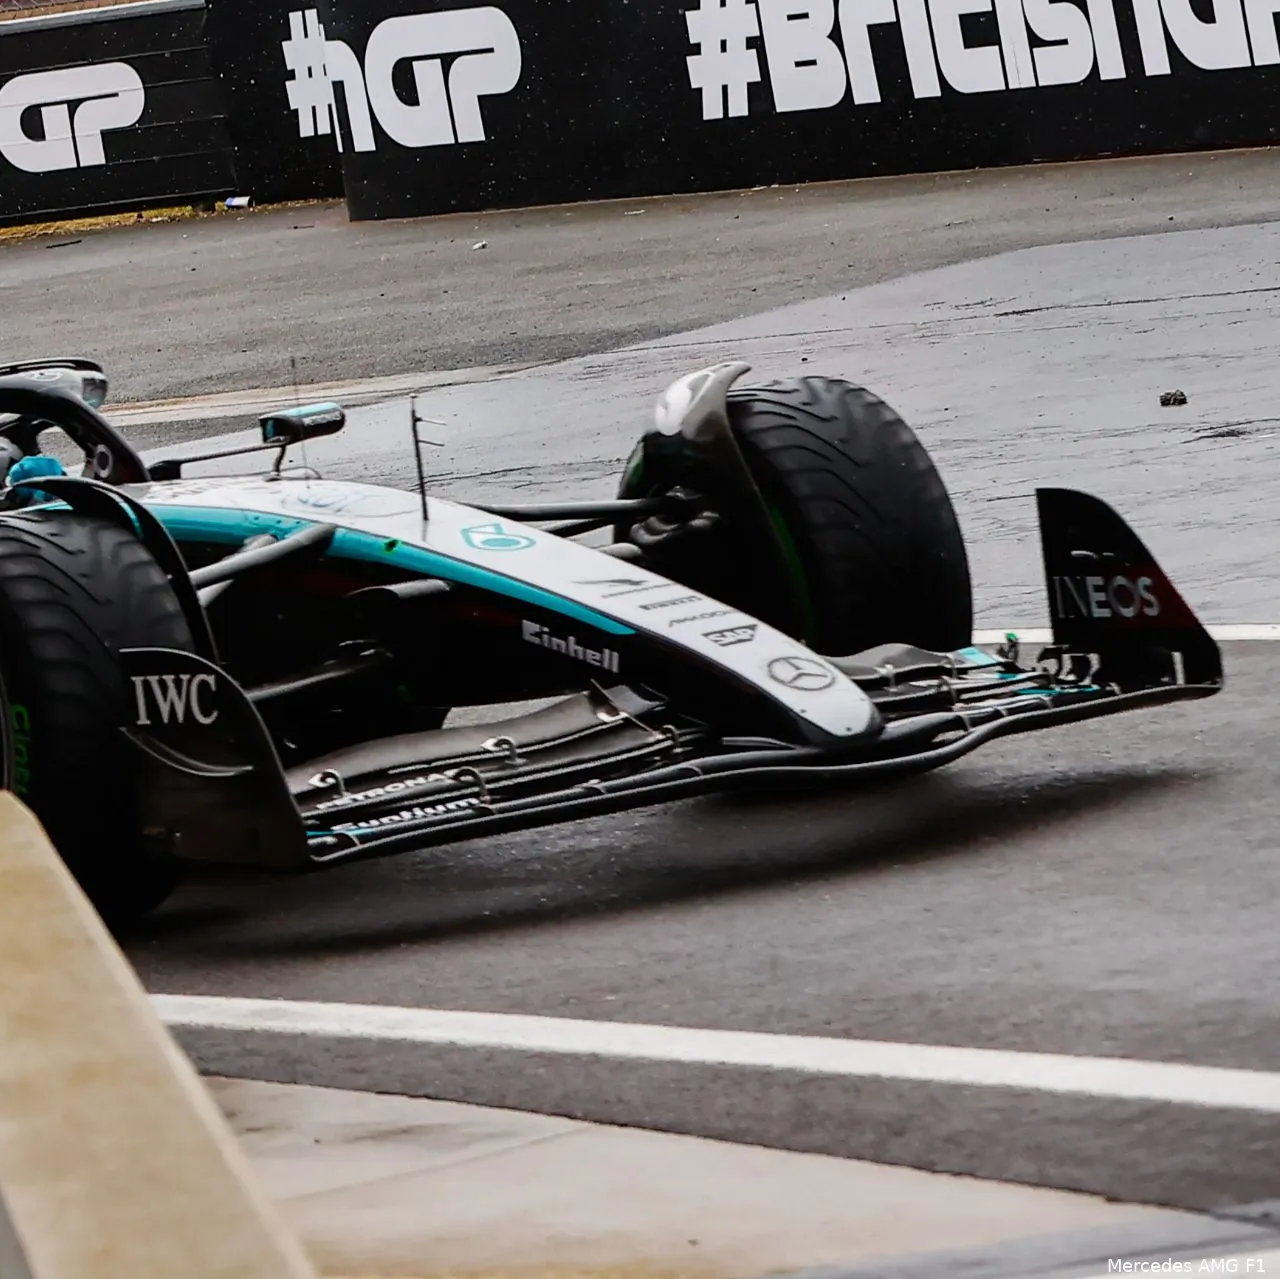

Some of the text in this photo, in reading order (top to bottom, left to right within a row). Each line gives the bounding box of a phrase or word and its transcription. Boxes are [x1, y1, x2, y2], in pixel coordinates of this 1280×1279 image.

[1051, 575, 1160, 619] INEOS
[522, 619, 620, 673] Einhell
[130, 673, 219, 725] IWC
